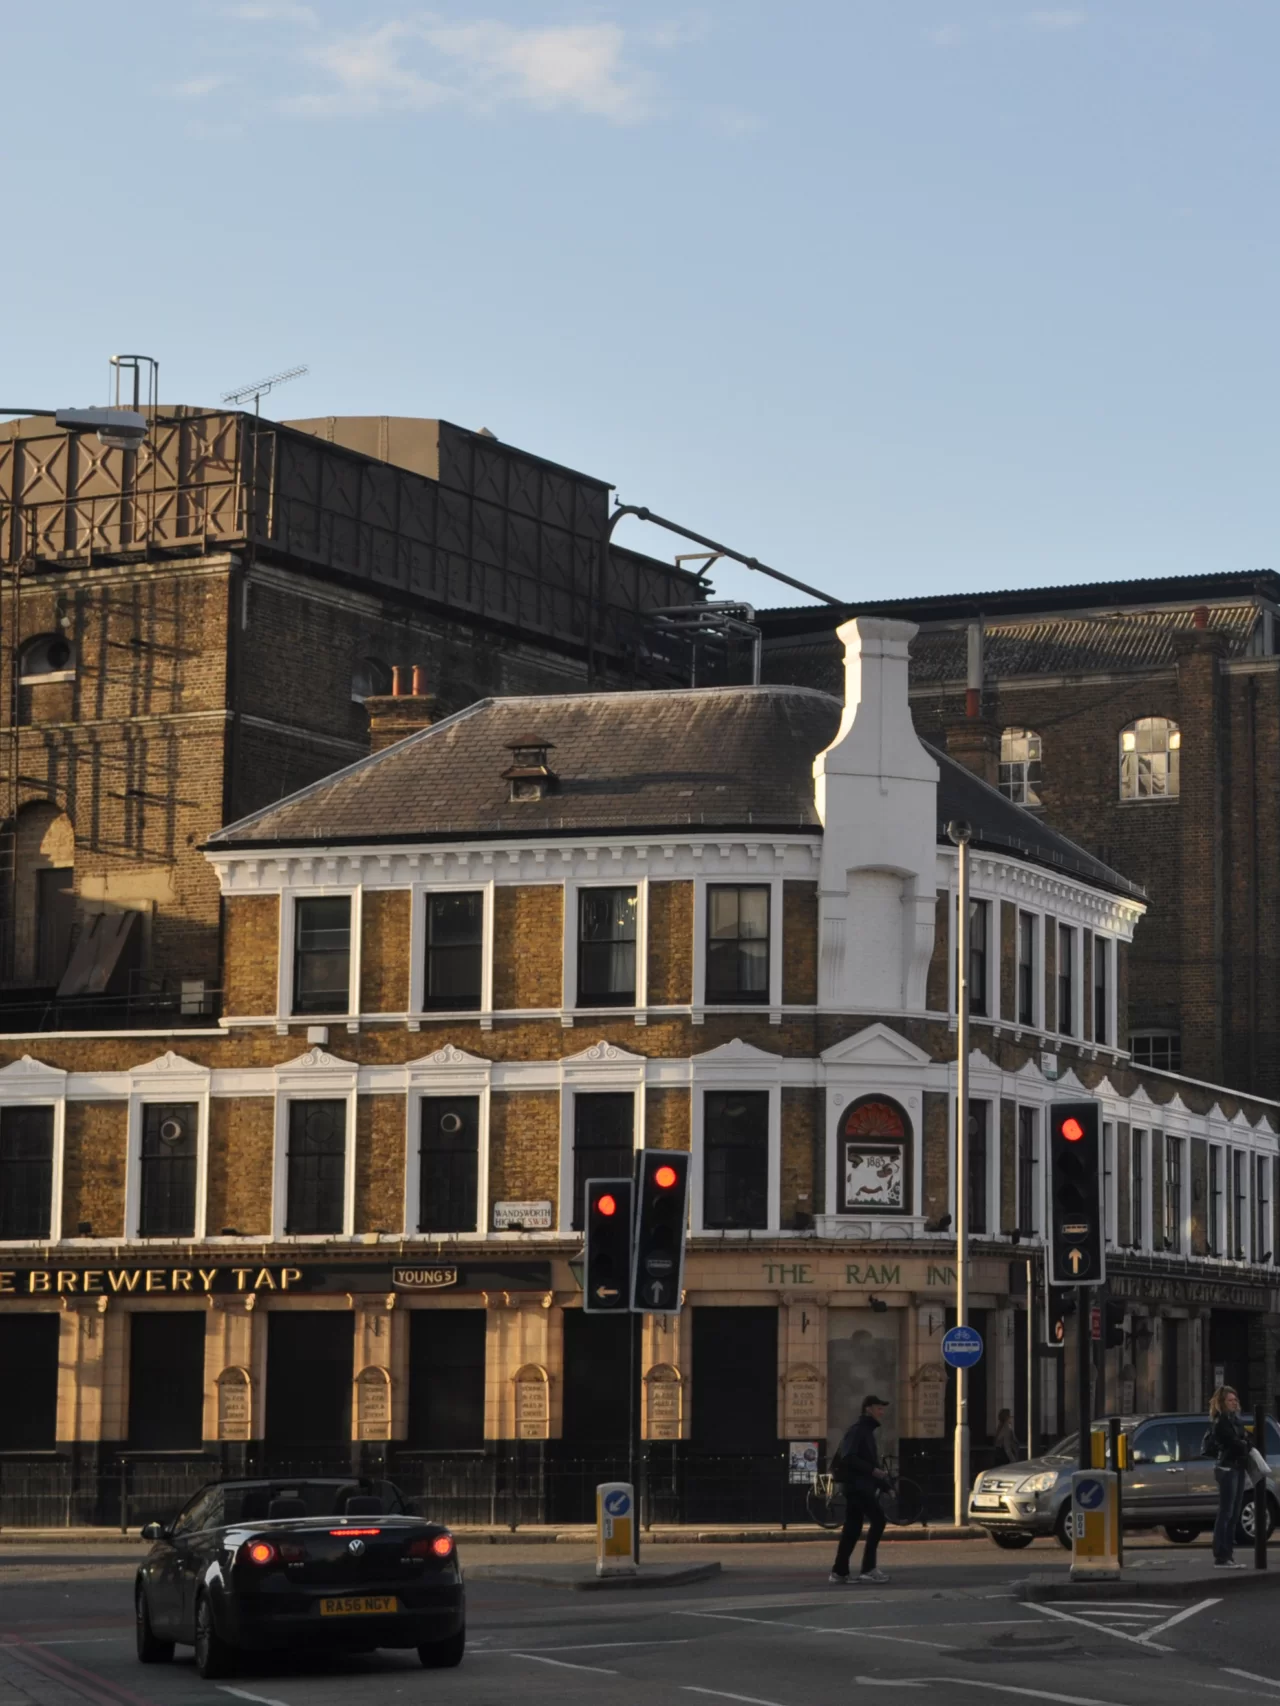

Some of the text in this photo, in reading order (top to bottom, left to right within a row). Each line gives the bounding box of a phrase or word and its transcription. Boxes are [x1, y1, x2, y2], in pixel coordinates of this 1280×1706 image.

[495, 1208, 551, 1218] WANDSWORTH
[29, 1268, 218, 1293] BREWERY
[232, 1267, 302, 1291] TAP
[762, 1263, 958, 1286] THE RAM INN
[326, 1599, 362, 1613] RA56
